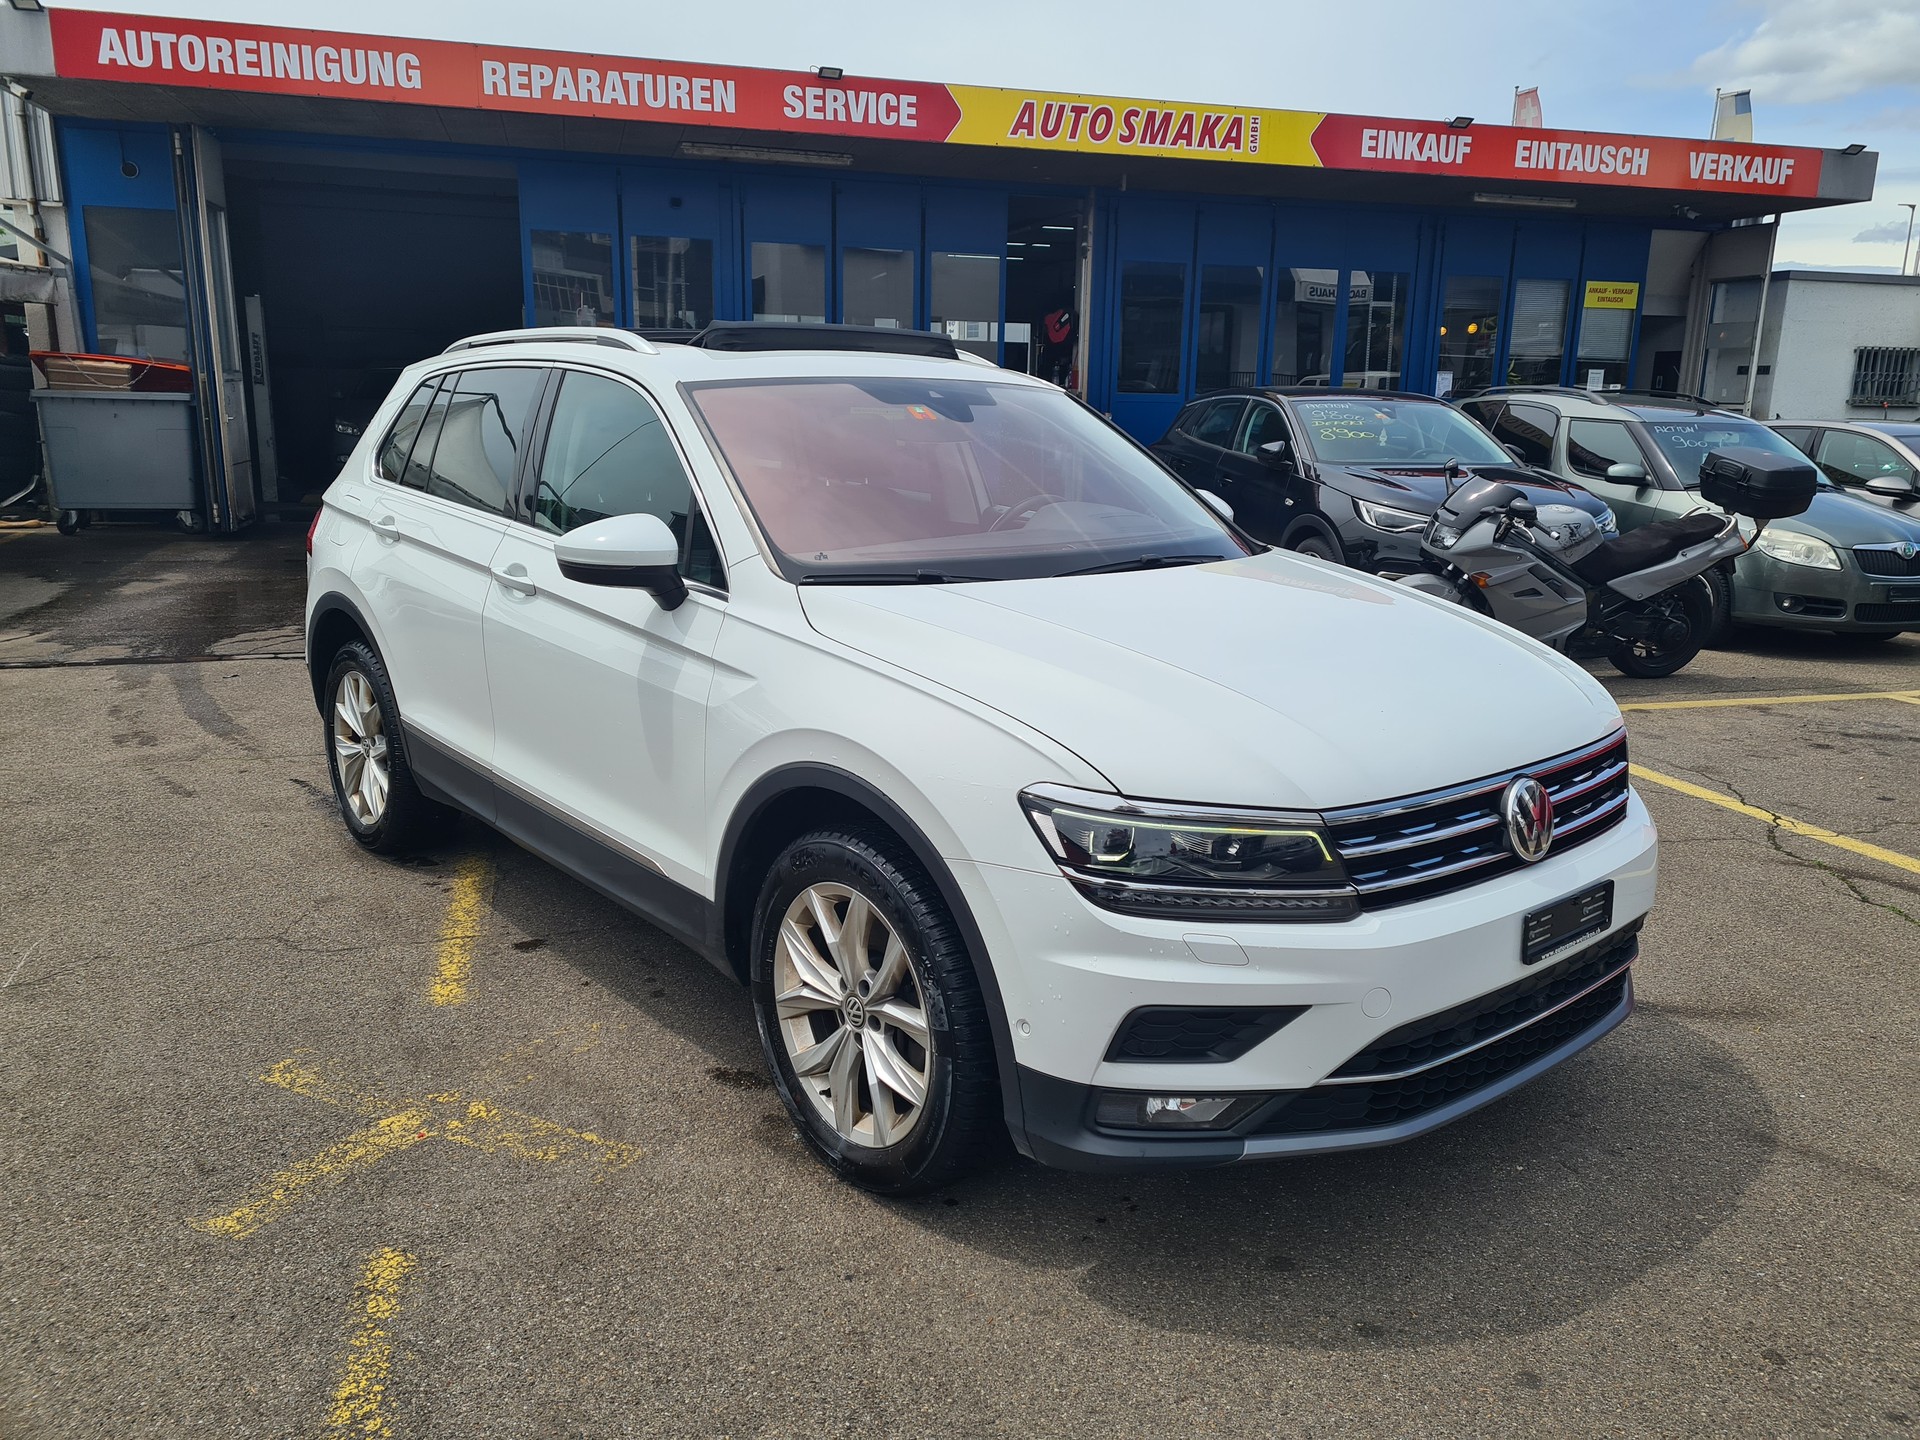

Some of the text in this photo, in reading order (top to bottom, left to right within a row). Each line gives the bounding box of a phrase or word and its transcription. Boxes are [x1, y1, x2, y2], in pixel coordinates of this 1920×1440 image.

[98, 28, 422, 90] AUTOREINIGUNG
[482, 61, 736, 114] REPARATUREN
[783, 85, 918, 127] SERVICE
[1009, 101, 1243, 151] AUTO SMAKA
[1249, 116, 1260, 153] GMBH
[1361, 129, 1473, 164] EINKAUF
[1514, 139, 1649, 176] EINTAUSCH
[1689, 151, 1795, 185] VERKAUF
